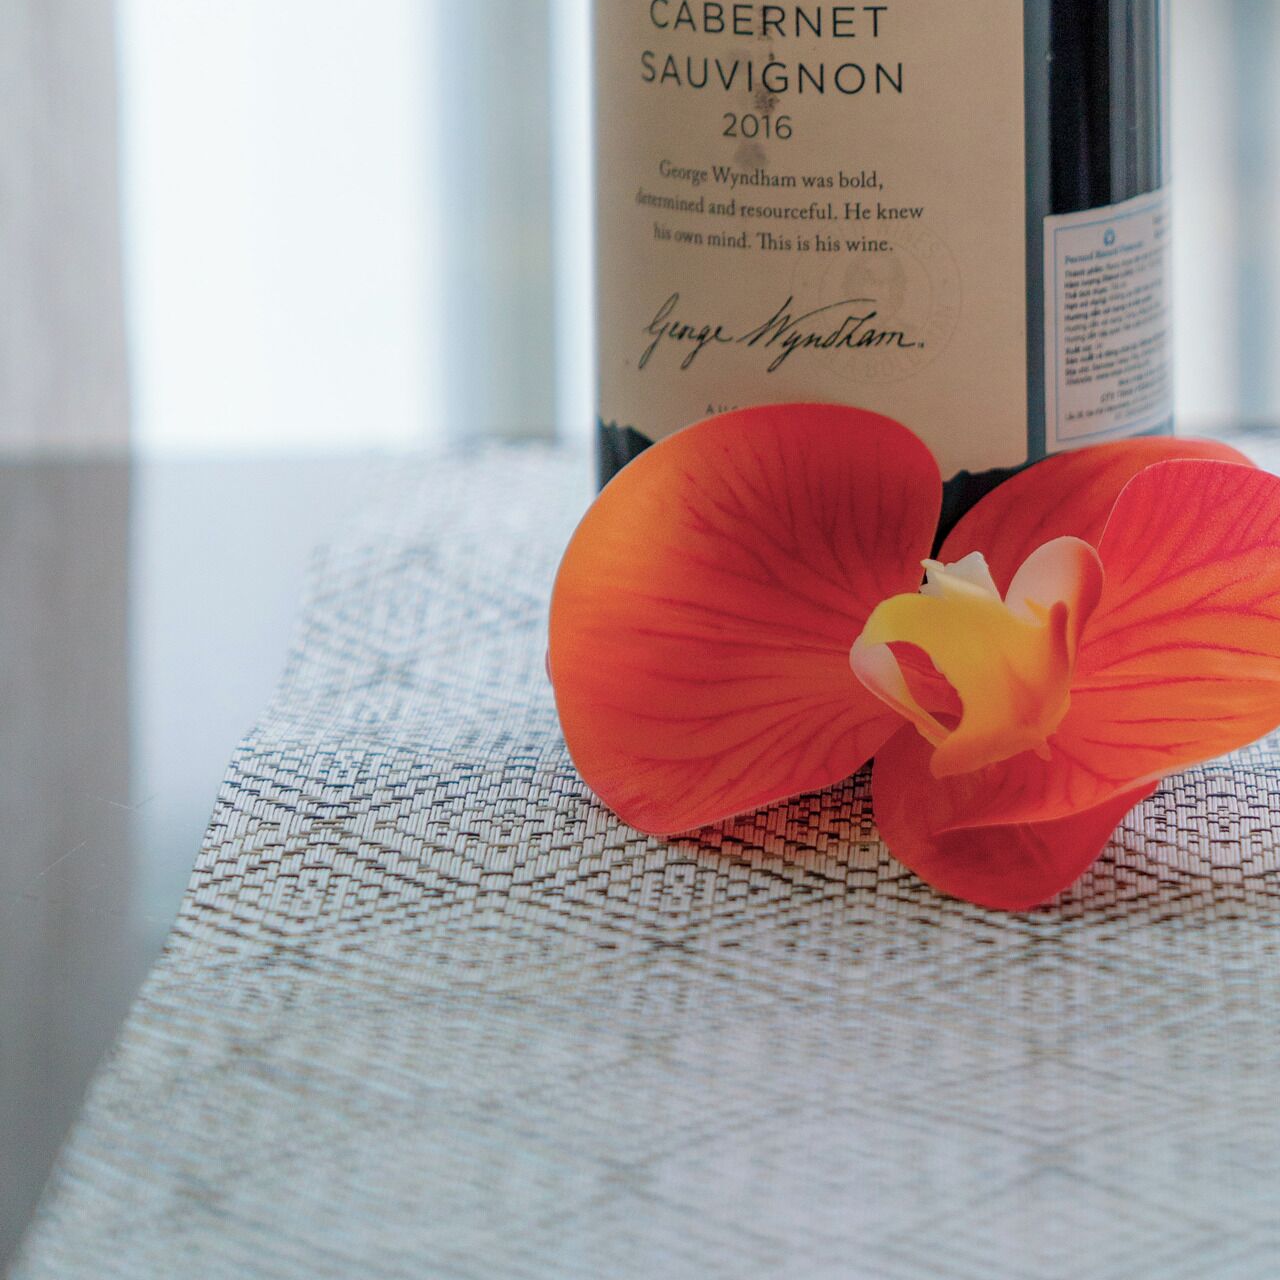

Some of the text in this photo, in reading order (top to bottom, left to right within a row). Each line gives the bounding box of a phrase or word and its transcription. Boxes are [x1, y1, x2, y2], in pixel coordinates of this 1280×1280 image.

[641, 50, 903, 95] SAUVIGNON
[722, 113, 793, 140] 2016
[659, 159, 884, 190] George Wyndham was bold,
[709, 198, 736, 217] and
[741, 202, 838, 220] resourceful.
[844, 202, 871, 220] He
[877, 202, 924, 220] knew
[653, 222, 893, 252] his own mind. This is his wine.
